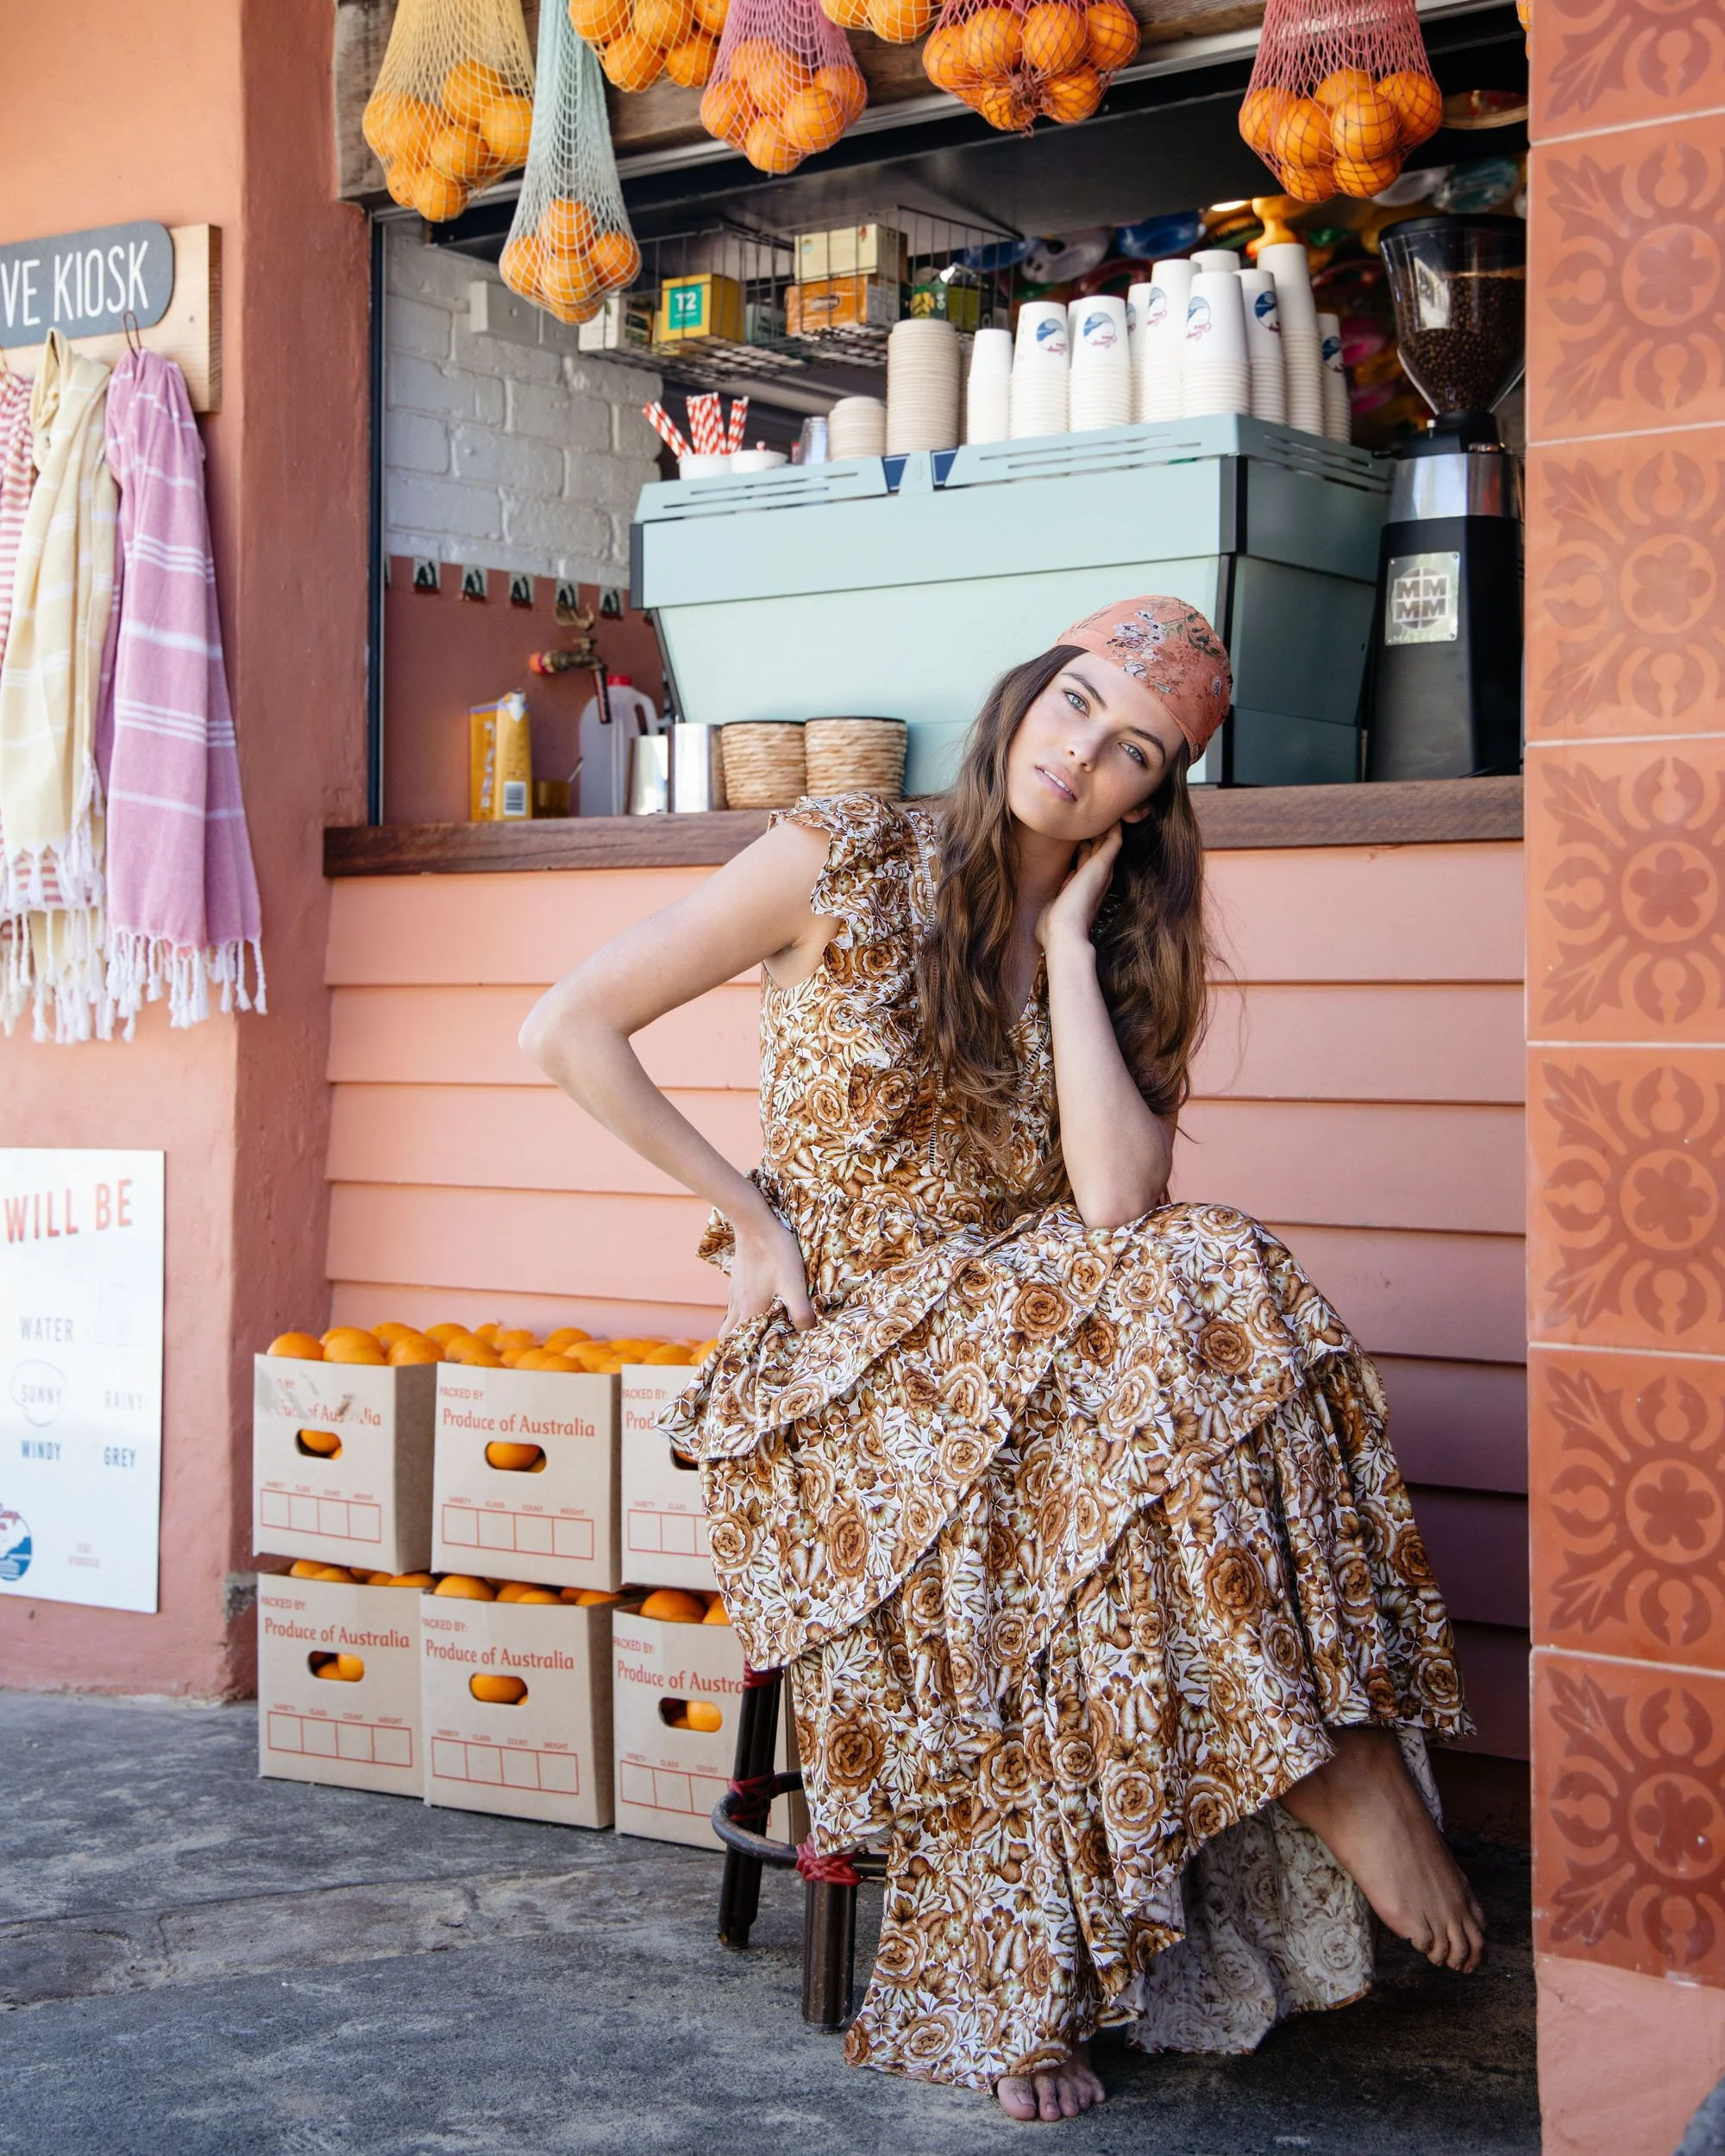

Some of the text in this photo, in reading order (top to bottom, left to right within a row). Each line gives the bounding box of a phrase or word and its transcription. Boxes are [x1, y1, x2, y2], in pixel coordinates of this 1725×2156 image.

[0, 240, 148, 328] VE KIOSK
[674, 291, 697, 311] T2
[4, 1178, 132, 1244] WILL BE
[20, 1316, 74, 1343] WATER
[22, 1383, 62, 1405] SUNNY
[104, 1389, 143, 1411] RAINY
[439, 1386, 471, 1399] PACKED
[621, 1388, 653, 1400] PACKED
[442, 1407, 595, 1438] Produce of Australia
[20, 1439, 62, 1461] WINDY
[103, 1445, 136, 1467] GREY
[522, 1504, 543, 1513] COUNT
[560, 1507, 585, 1516] WEIGHT
[260, 1595, 292, 1609] PACKED
[265, 1617, 410, 1648] Produce of Australia
[426, 1639, 574, 1670] Produce of Australia
[613, 1636, 641, 1652] PACKED
[618, 1660, 664, 1688] Produce
[668, 1670, 686, 1689] of
